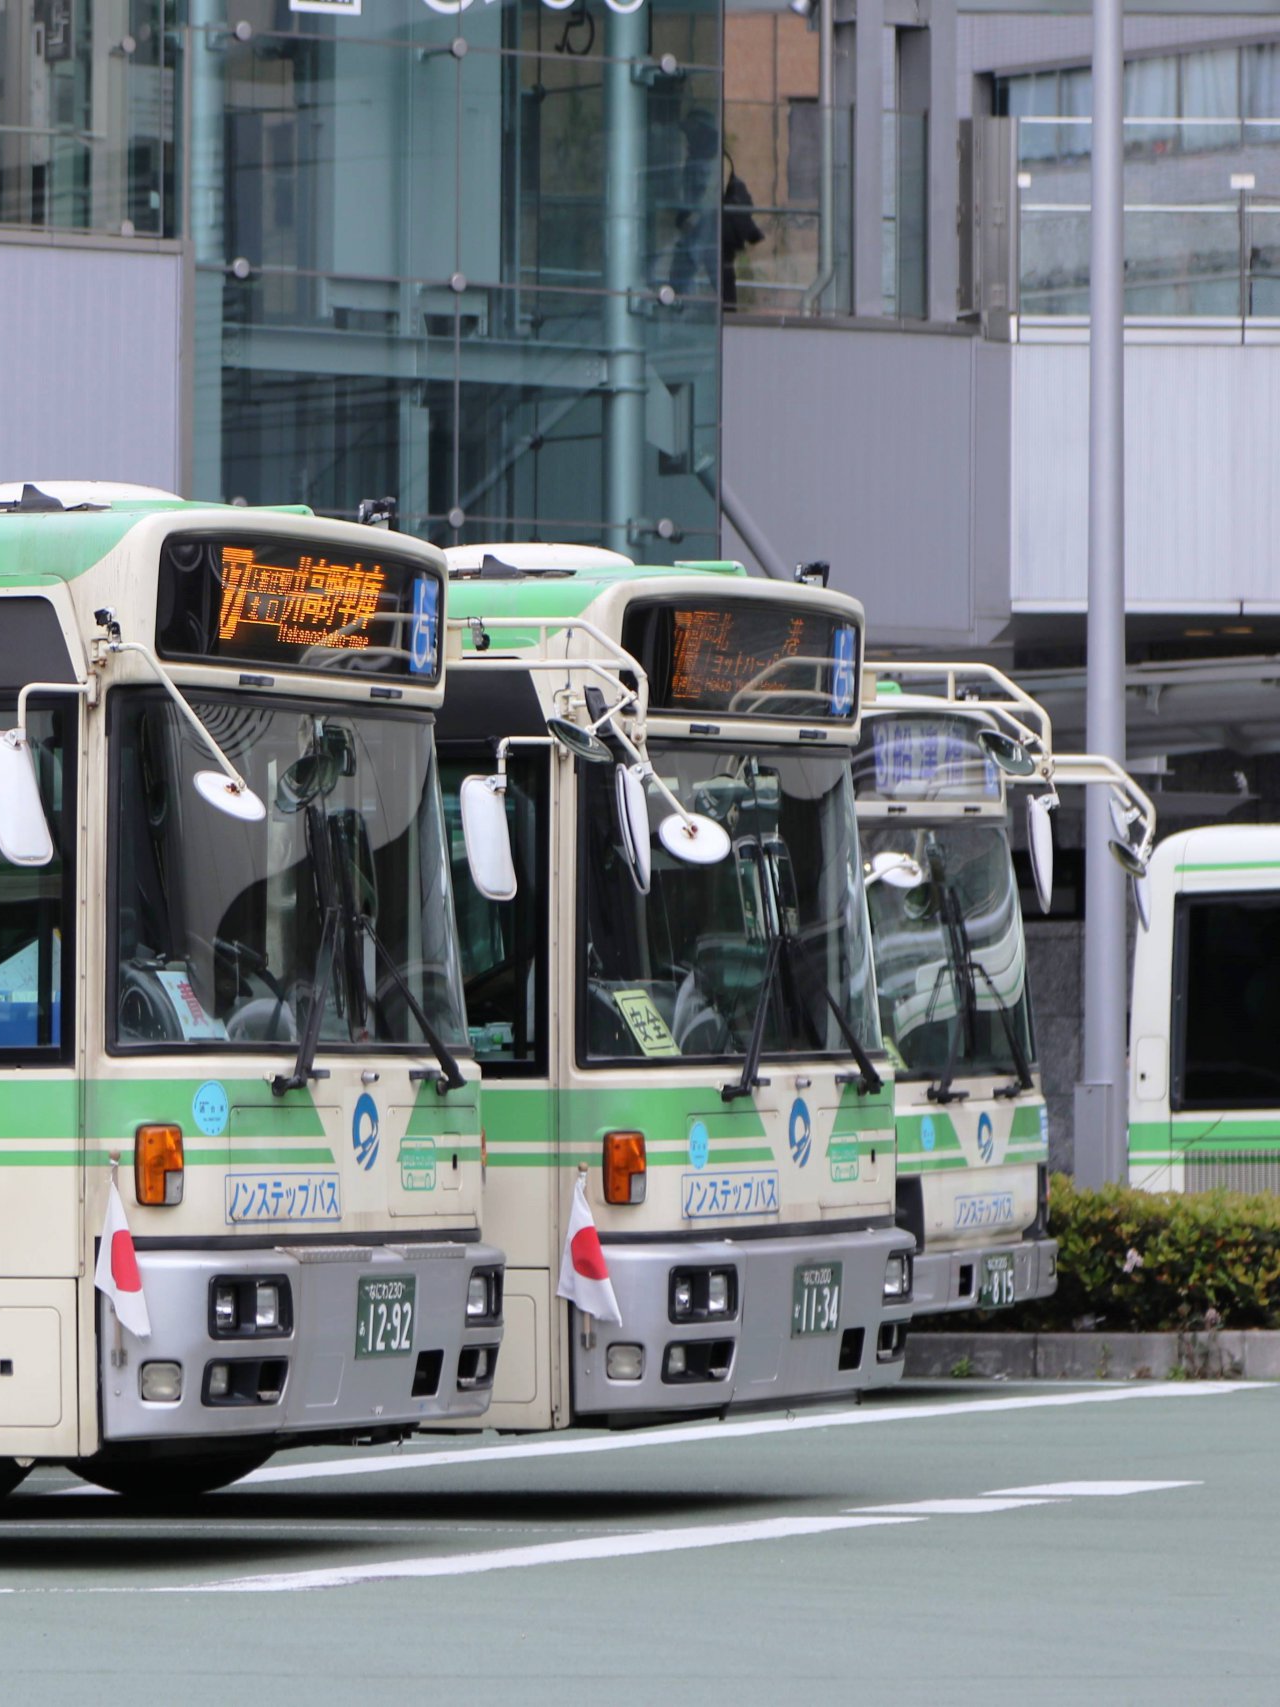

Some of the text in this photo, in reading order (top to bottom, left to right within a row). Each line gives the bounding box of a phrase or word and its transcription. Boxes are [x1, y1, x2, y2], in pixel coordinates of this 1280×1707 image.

[629, 1006, 668, 1043] 安全
[229, 1178, 339, 1217] ノンステップバス
[684, 1176, 777, 1212] ノンステップバス
[957, 1196, 1014, 1225] ノンステップバス
[368, 1301, 412, 1352] 12-92
